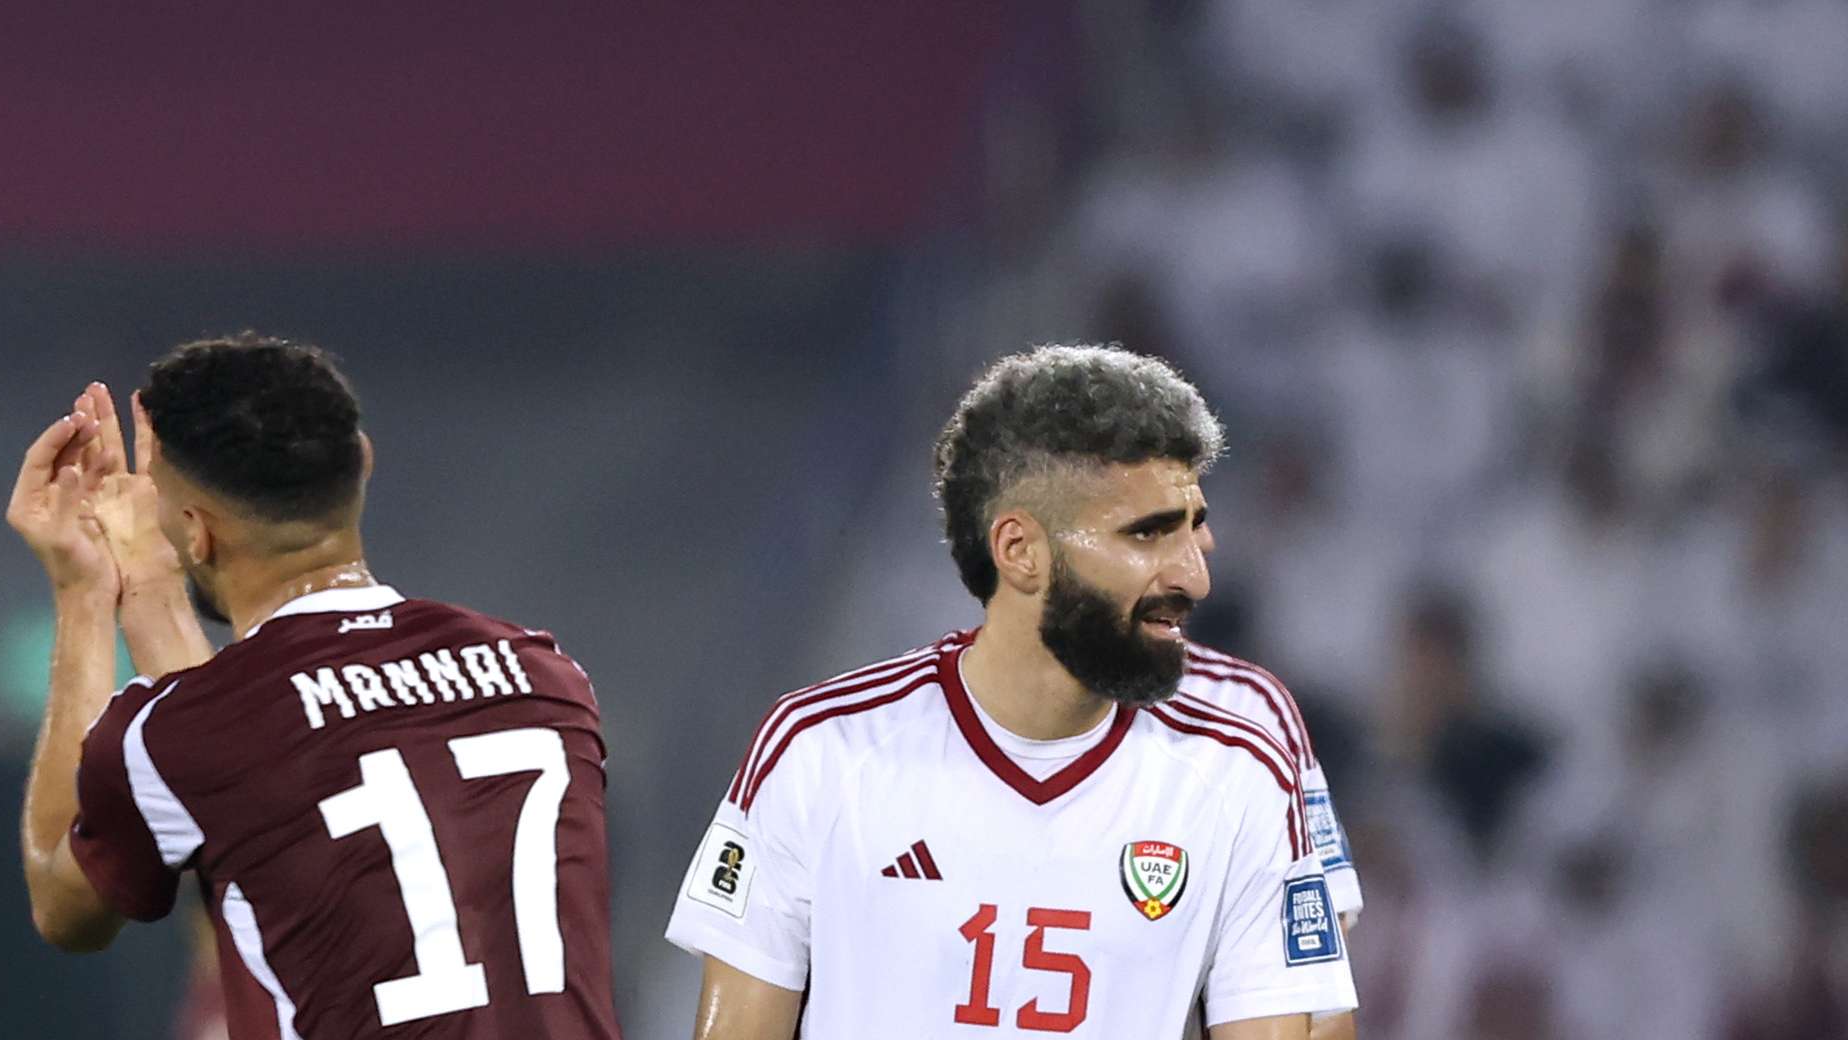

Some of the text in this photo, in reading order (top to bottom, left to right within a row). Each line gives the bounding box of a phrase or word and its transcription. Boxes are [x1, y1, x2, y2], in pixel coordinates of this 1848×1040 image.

[288, 639, 533, 729] MANNAI
[317, 727, 571, 1027] 17
[1140, 862, 1172, 876] UAE
[1147, 875, 1164, 886] FA
[954, 903, 1092, 1033] 15
